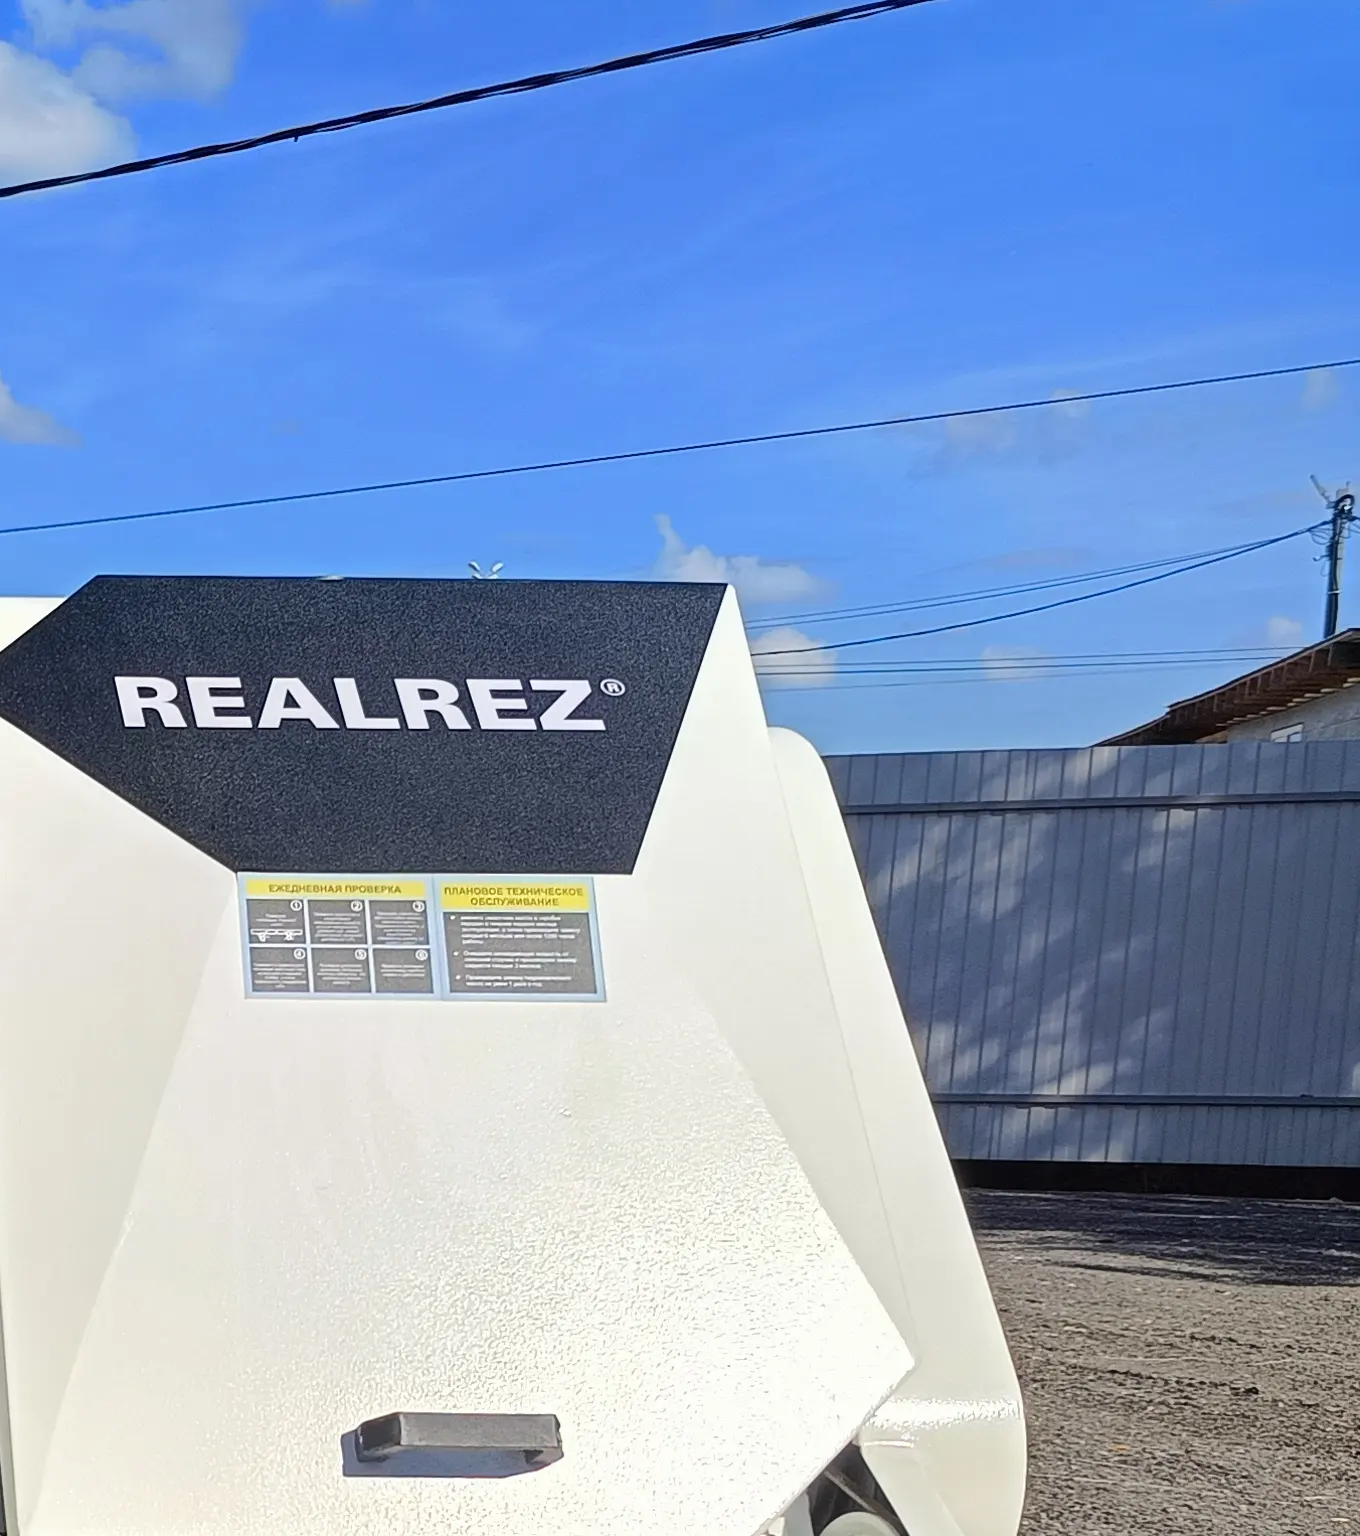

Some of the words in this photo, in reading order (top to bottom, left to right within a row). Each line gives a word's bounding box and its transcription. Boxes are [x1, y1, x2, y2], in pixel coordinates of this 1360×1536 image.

[268, 883, 343, 894] ЕЖЕДНЕВНАЯ
[344, 884, 402, 894] ПРОВЕРКА
[444, 886, 503, 896] ПЛАНОВОЕ
[505, 887, 584, 896] ТЕХНИЧЕСКОЕ
[470, 897, 560, 906] ОБСЛУЖИВАНИЕ
